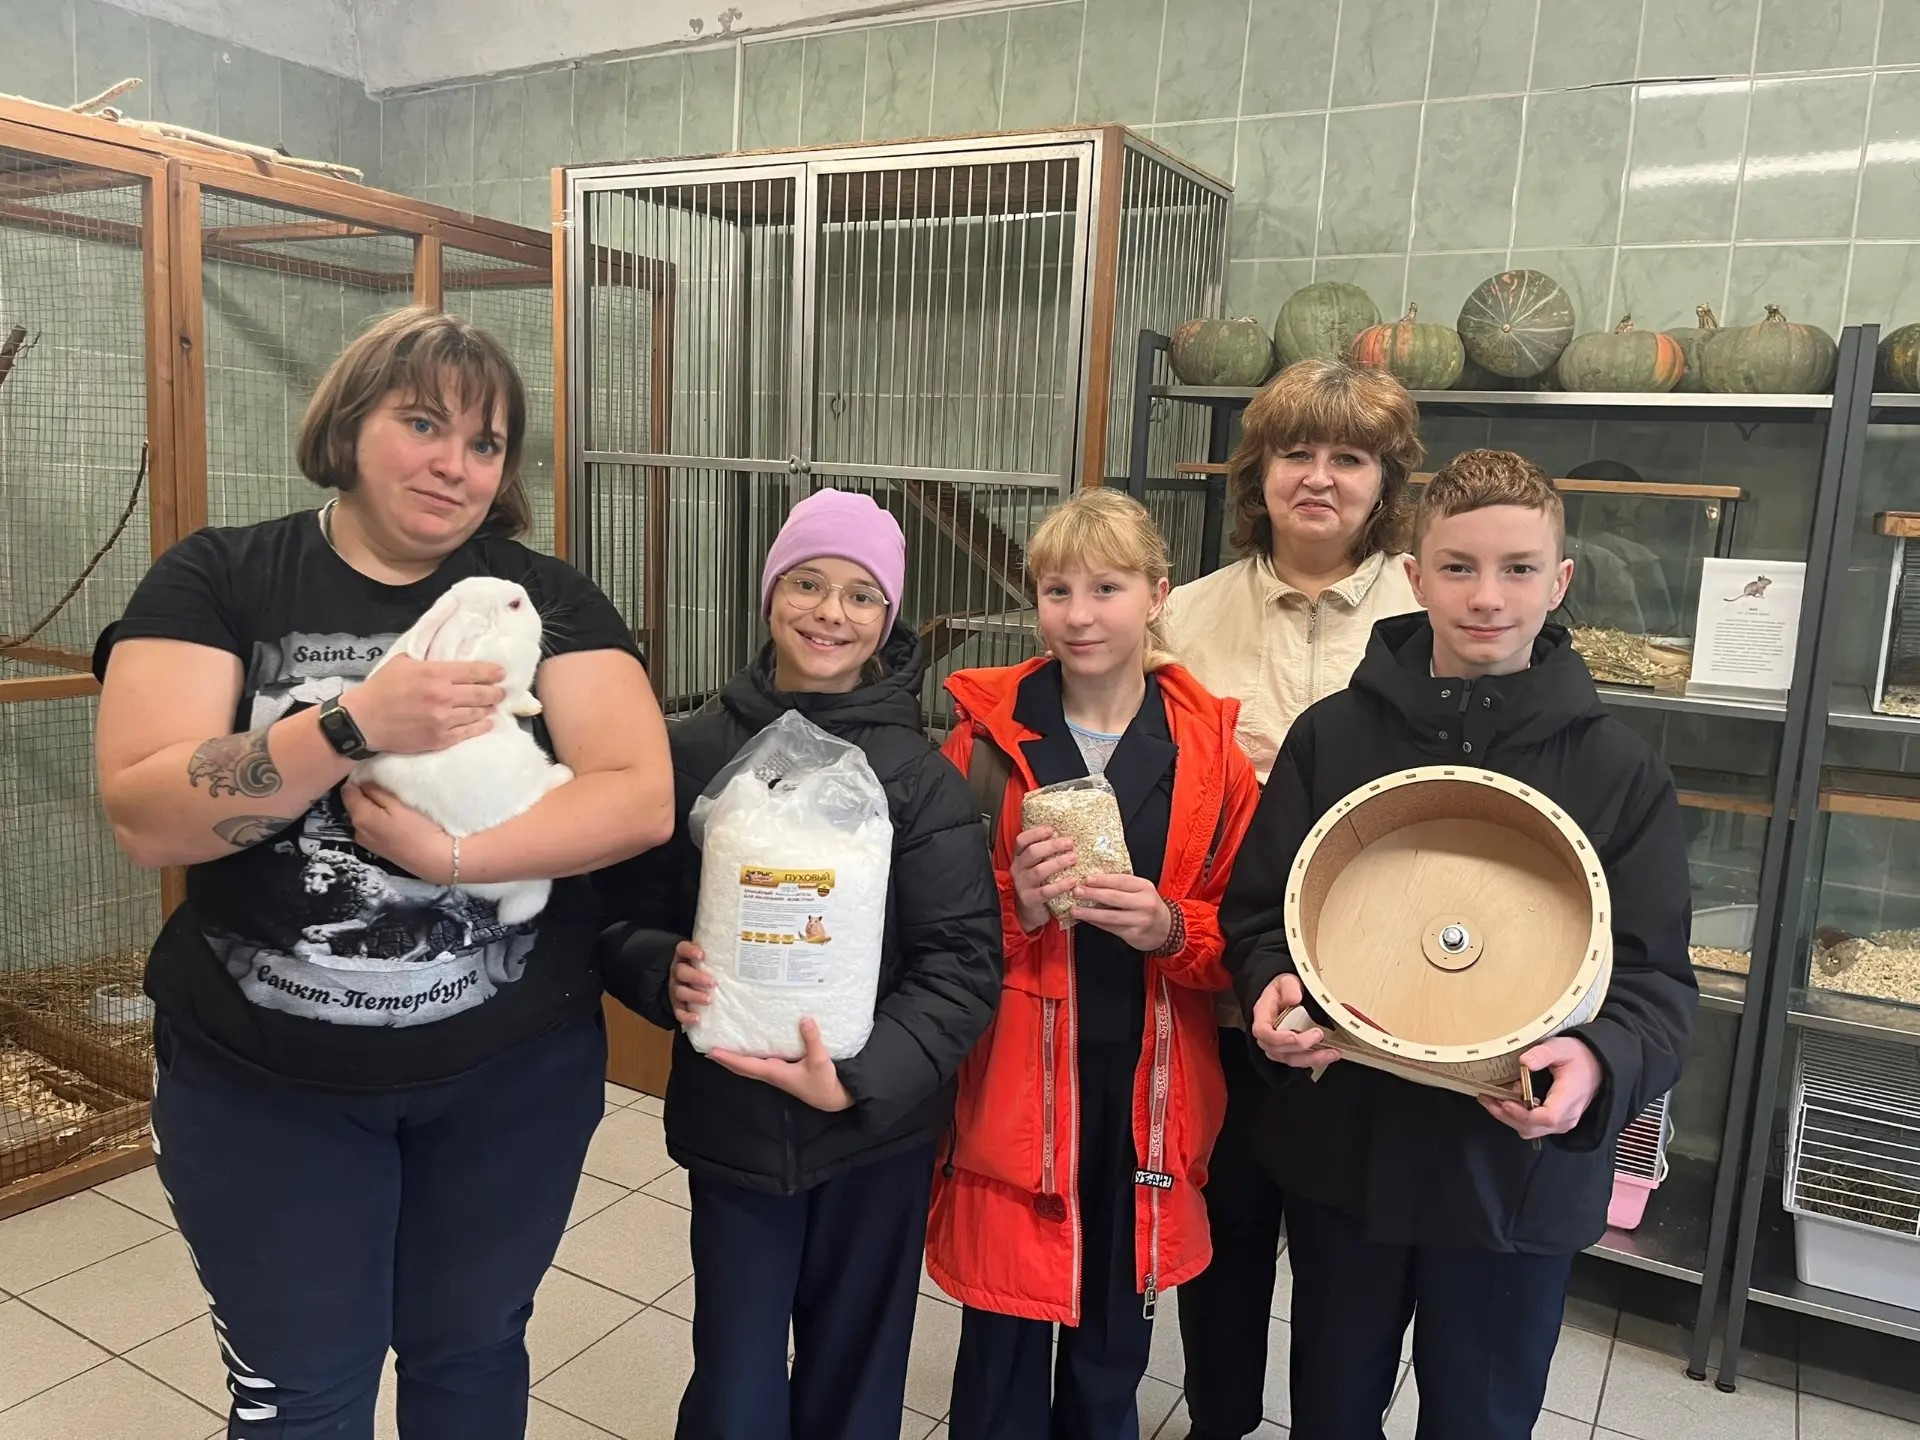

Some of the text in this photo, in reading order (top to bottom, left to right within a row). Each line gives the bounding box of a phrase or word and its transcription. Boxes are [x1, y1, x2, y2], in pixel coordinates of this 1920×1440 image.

[292, 645, 385, 663] Saint-P
[784, 872, 831, 882] ПУХОВЫЙ
[256, 964, 479, 1013] Санкт-Петербург
[1136, 1172, 1171, 1187] YEAH!
